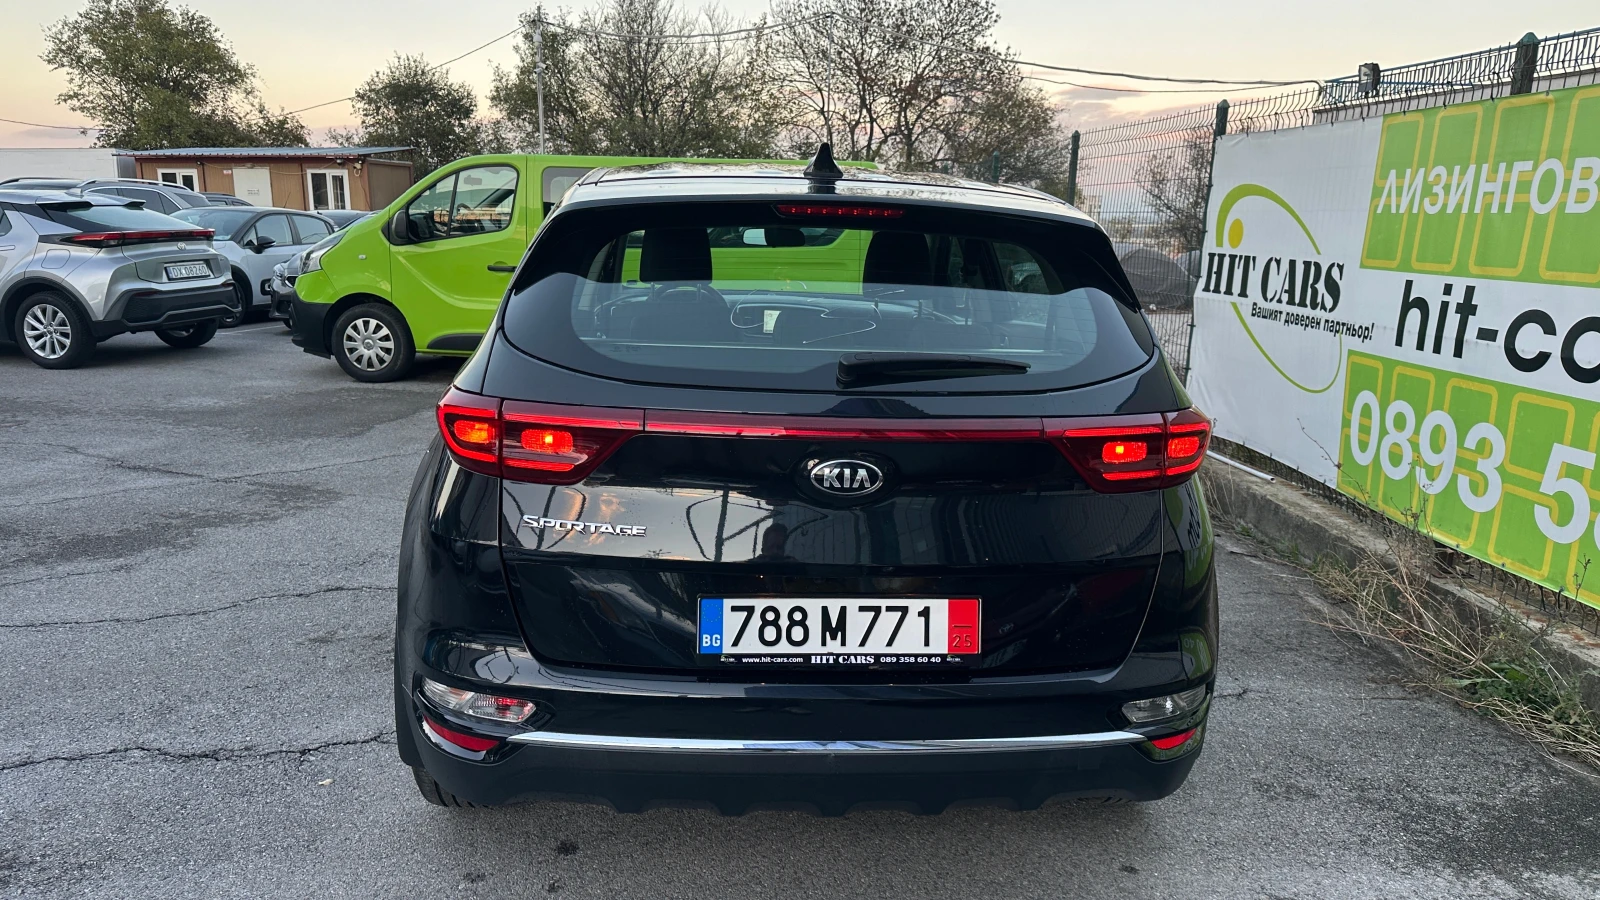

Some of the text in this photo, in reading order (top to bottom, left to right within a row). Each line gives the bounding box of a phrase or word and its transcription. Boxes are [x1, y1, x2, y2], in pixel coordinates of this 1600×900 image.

[1376, 157, 1600, 214] ЛИЗИНГОВ
[1202, 252, 1344, 313] HIT CARS
[1251, 302, 1375, 343] Вашият доверен партньор!
[823, 467, 871, 489] KIA
[1350, 390, 1600, 553] 0893 5
[522, 515, 647, 538] SPORTAGE
[702, 634, 721, 647] BG
[730, 605, 931, 647] 788 M 771
[952, 634, 973, 648] 25
[811, 655, 836, 664] HIT
[838, 655, 875, 664] CARS
